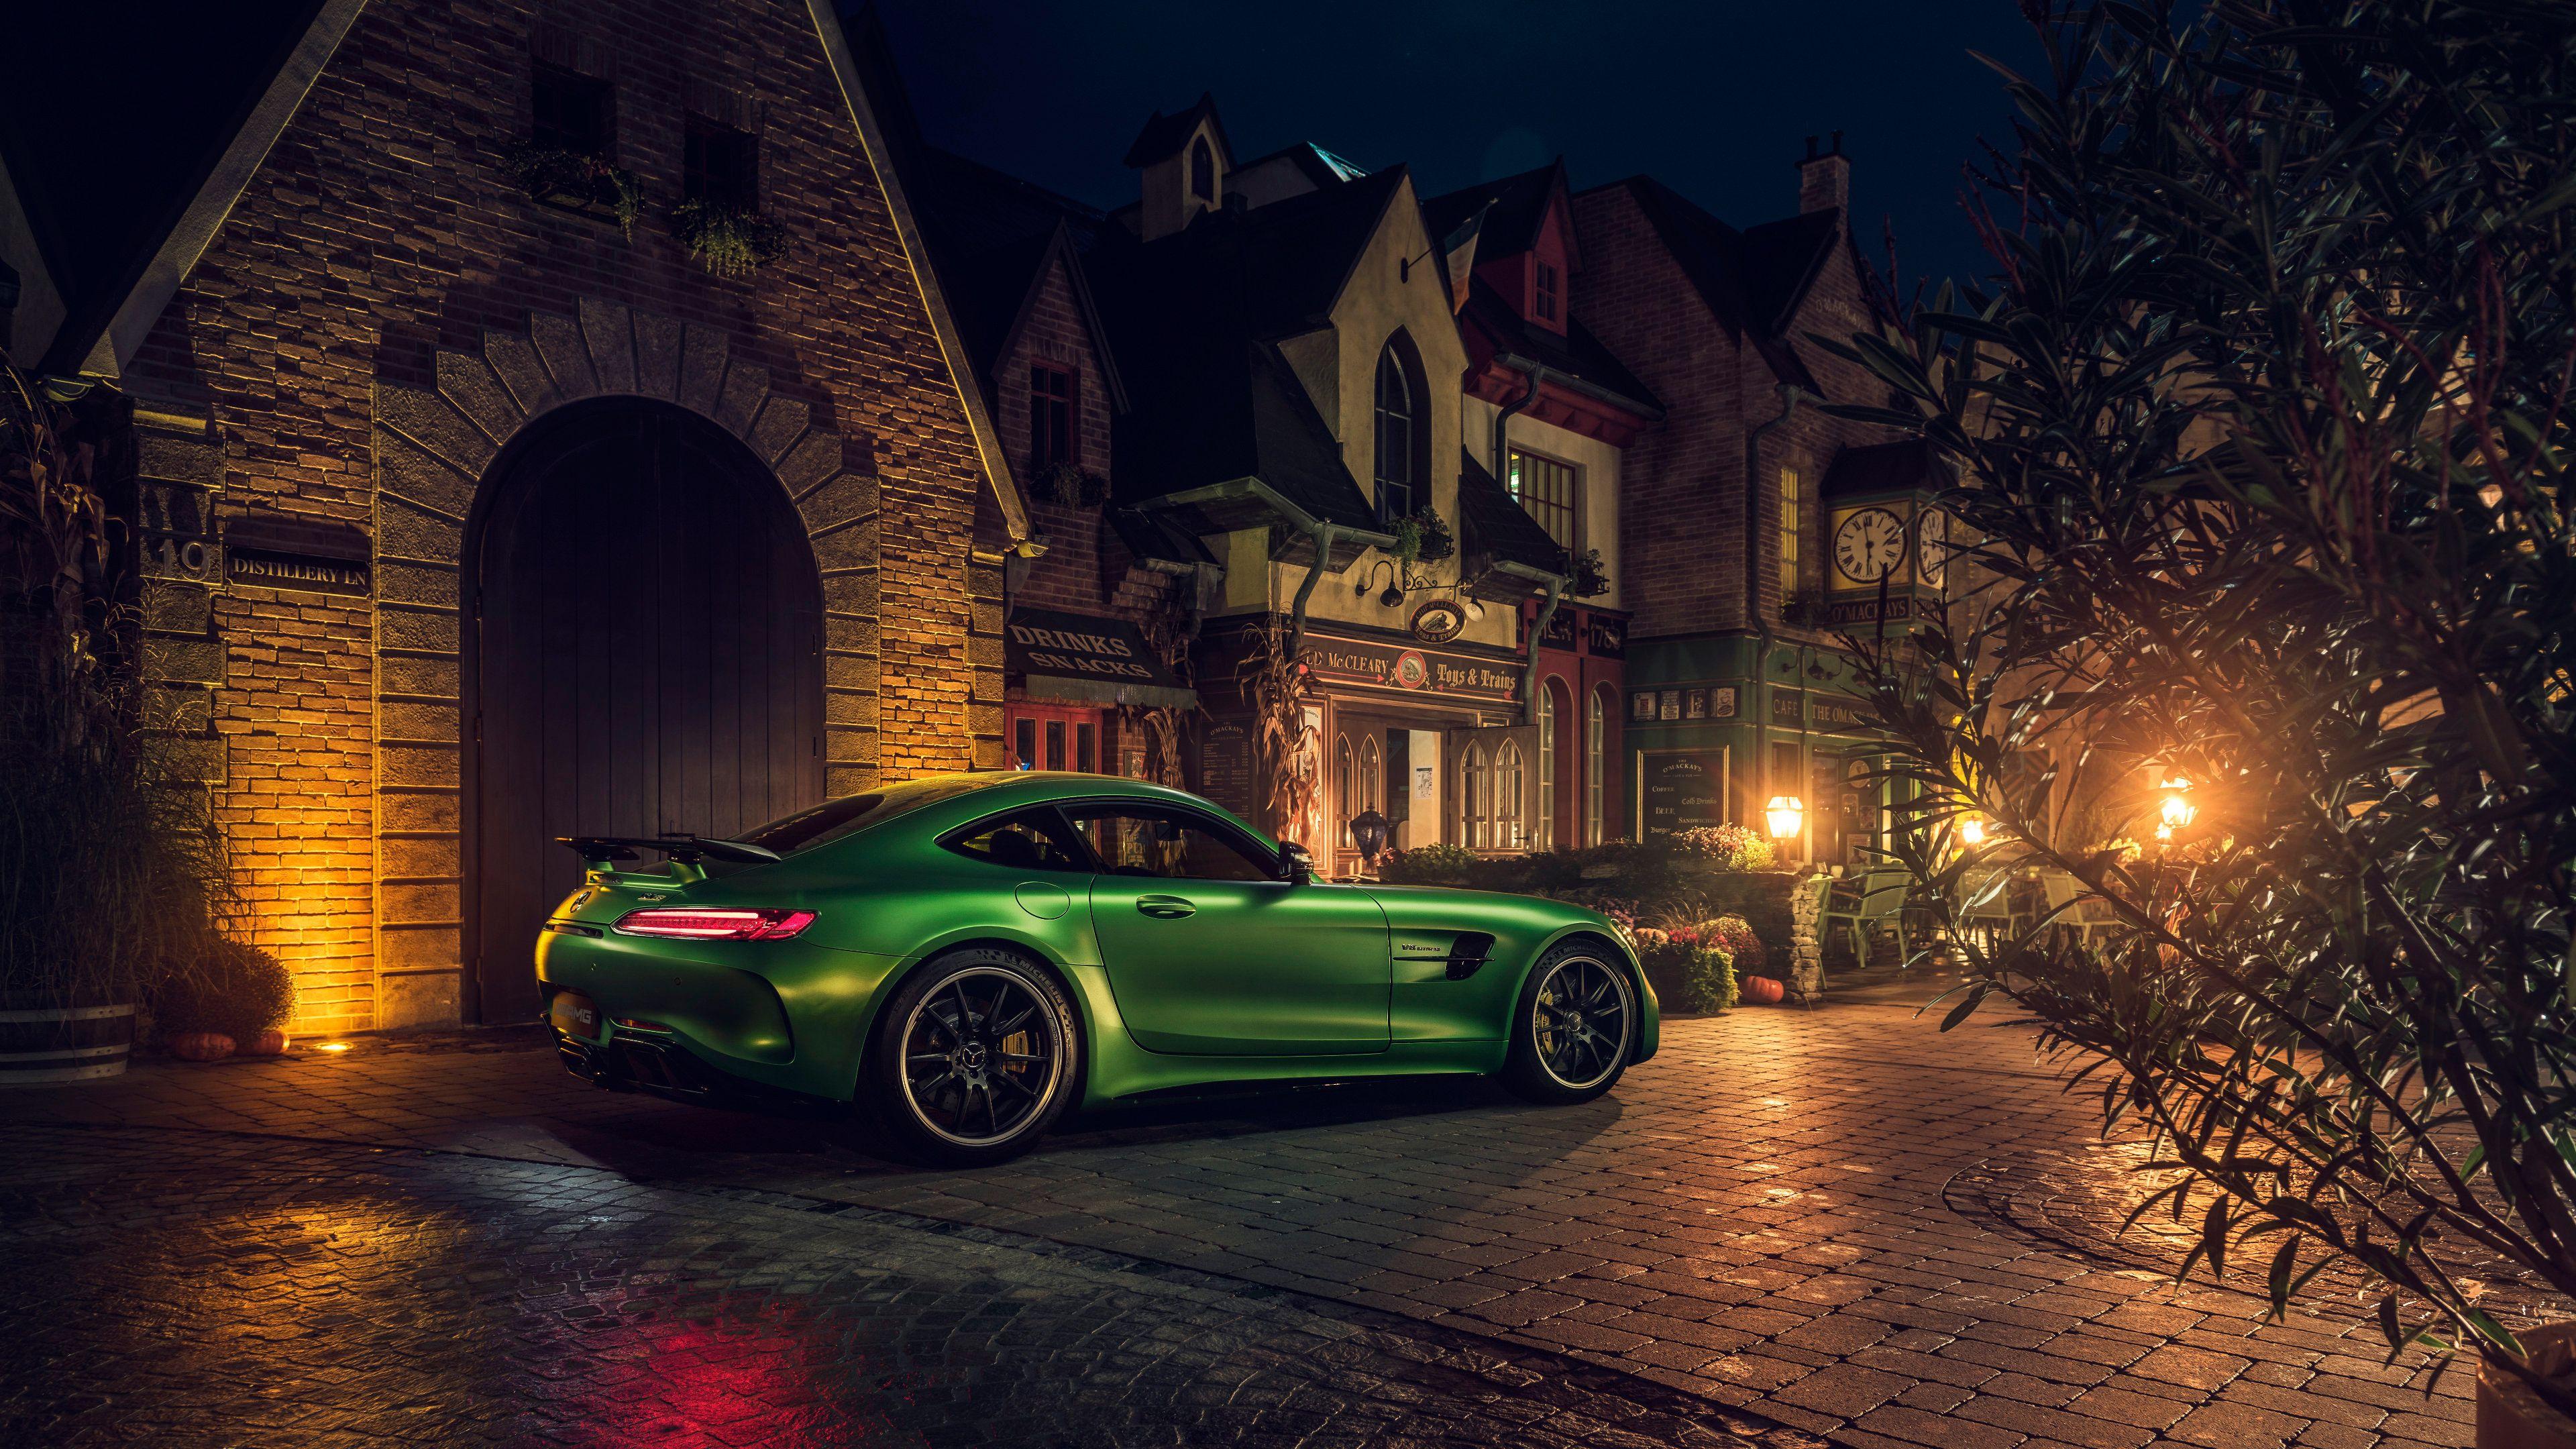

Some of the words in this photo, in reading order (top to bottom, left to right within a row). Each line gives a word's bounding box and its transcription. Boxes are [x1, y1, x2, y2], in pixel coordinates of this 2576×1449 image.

[158, 538, 210, 582] 19
[233, 557, 337, 583] DISTILLERY
[344, 568, 367, 586] LN
[1008, 625, 1132, 657] DRINKS
[1028, 652, 1153, 678] SNACKS
[1437, 663, 1466, 688] Toys
[1467, 669, 1478, 685] &
[1481, 669, 1516, 691] Trains
[1813, 704, 1830, 720] THE
[1019, 959, 1064, 1008] MICHELIN
